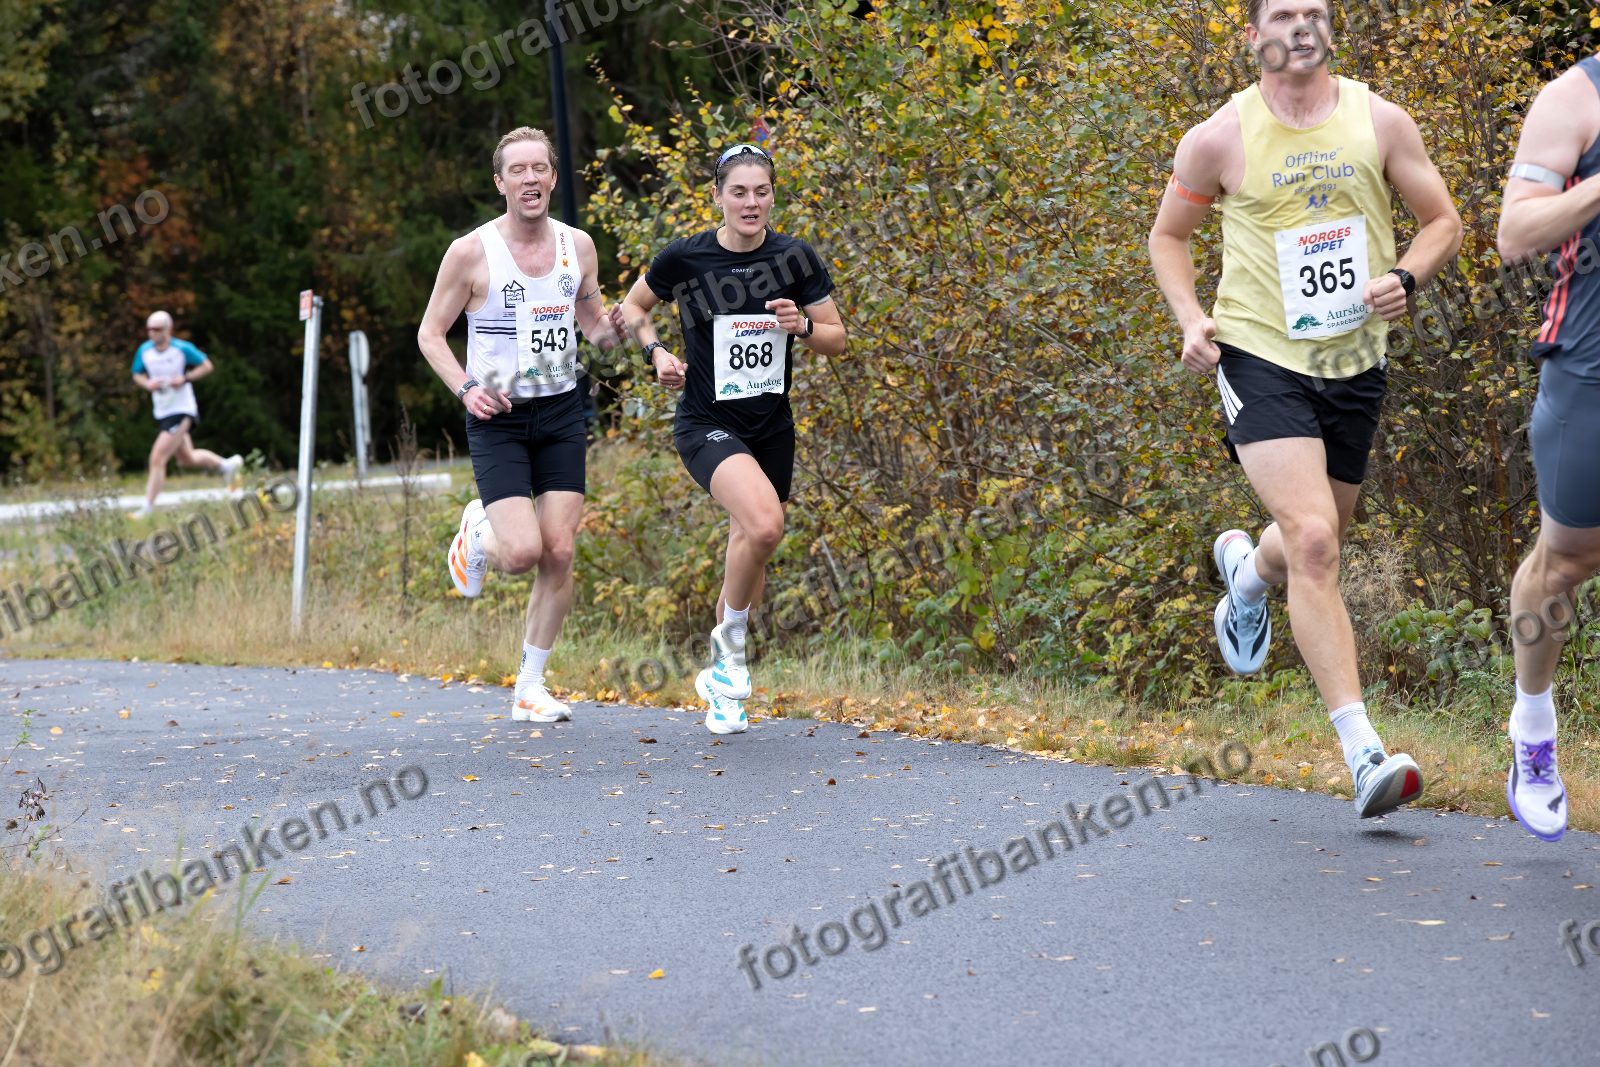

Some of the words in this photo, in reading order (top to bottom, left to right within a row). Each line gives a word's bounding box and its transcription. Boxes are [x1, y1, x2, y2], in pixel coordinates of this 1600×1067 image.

[1285, 150, 1337, 168] Offline
[1272, 172, 1306, 188] Run
[1312, 162, 1355, 180] Club
[1294, 186, 1315, 195] since
[1318, 183, 1337, 191] 1991
[1299, 227, 1351, 246] NORGES
[1304, 239, 1345, 255] LØPET
[1299, 257, 1355, 297] 365
[531, 304, 570, 315] NORGES
[534, 313, 565, 322] LØPET
[732, 321, 776, 330] NORGES
[735, 329, 769, 337] LØPET
[531, 327, 569, 354] 543
[729, 342, 773, 370] 868
[746, 378, 782, 389] Aurskog
